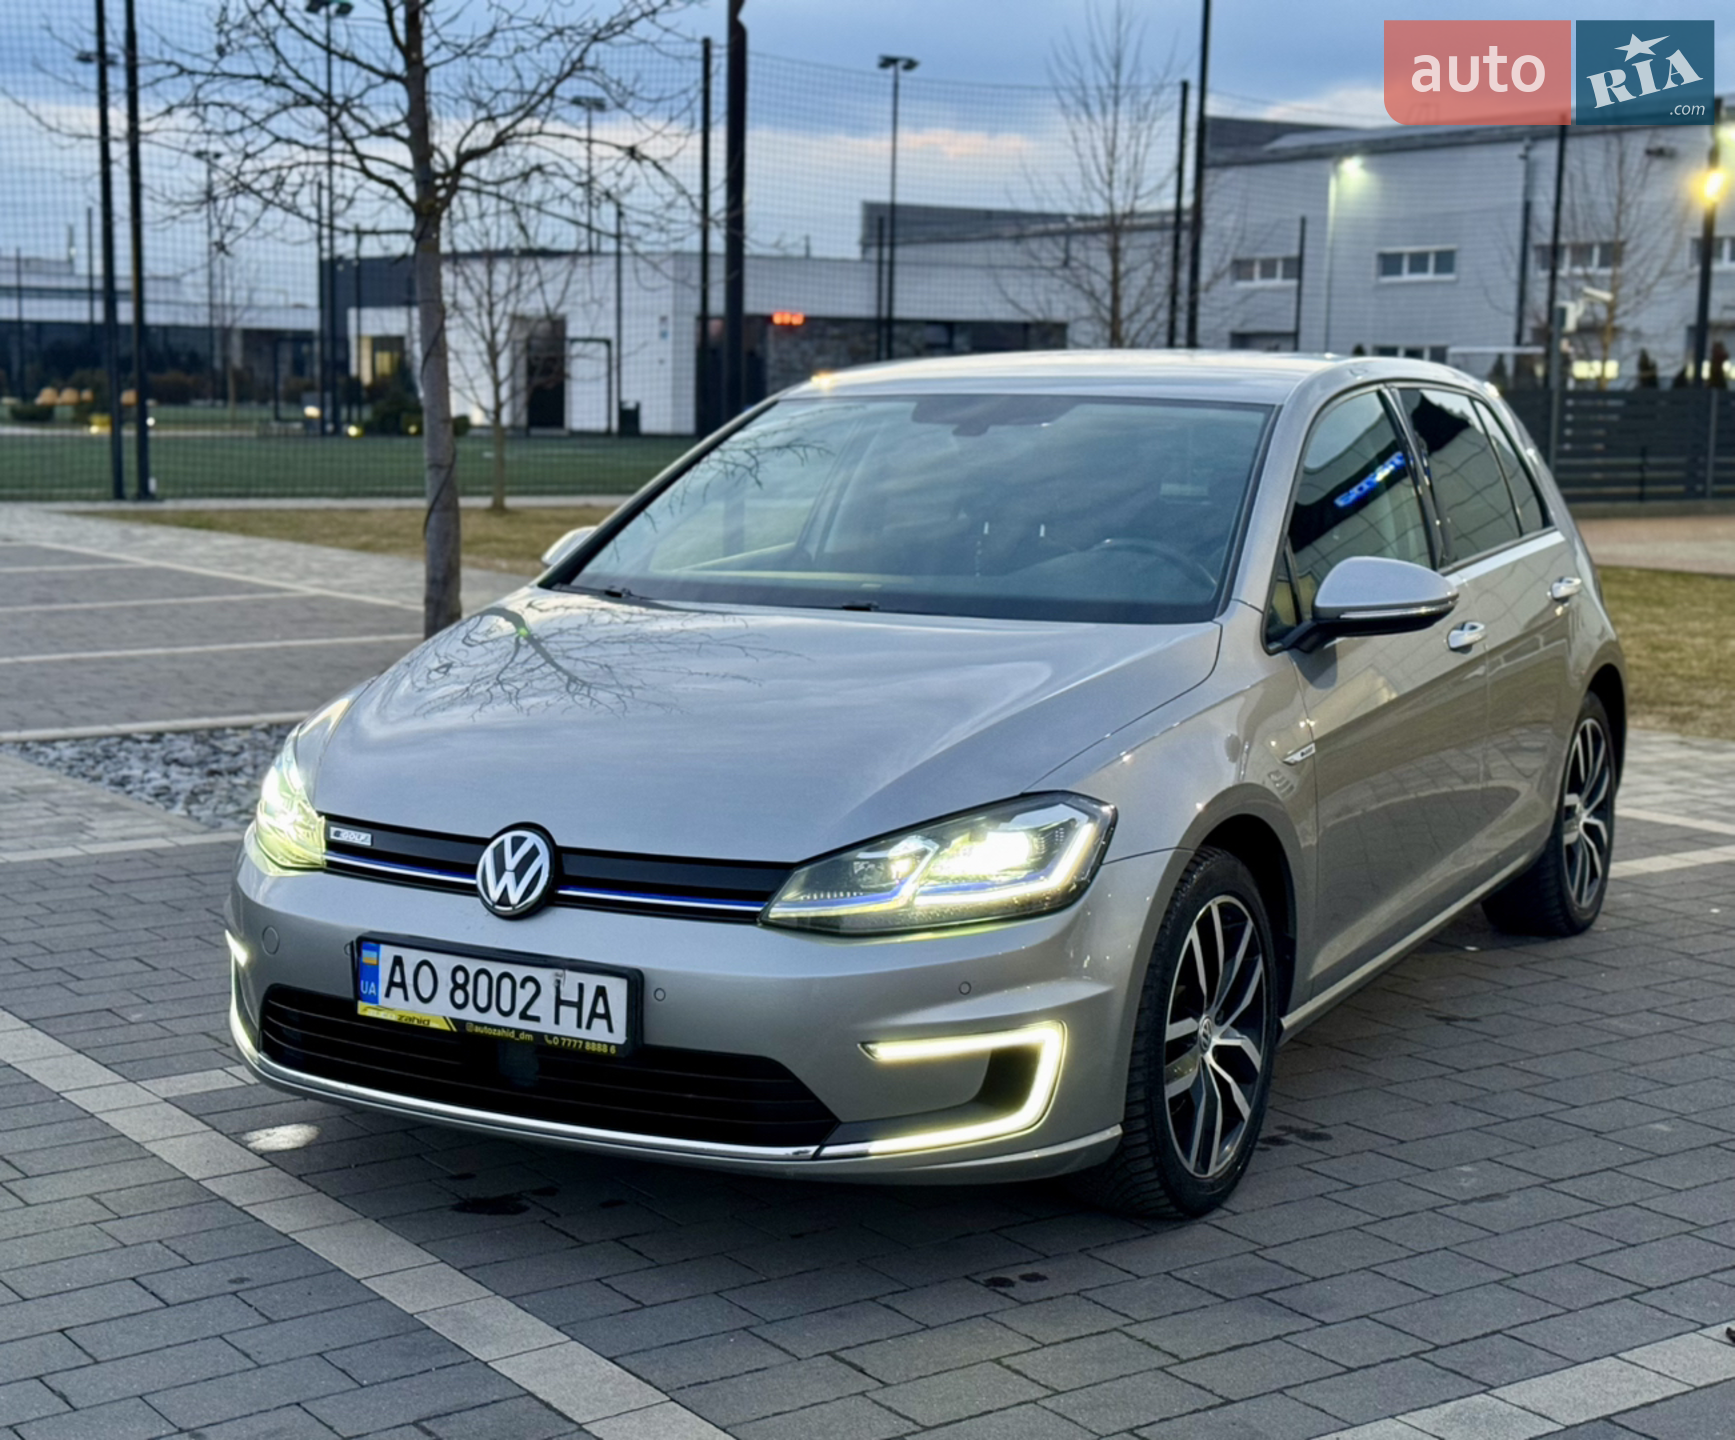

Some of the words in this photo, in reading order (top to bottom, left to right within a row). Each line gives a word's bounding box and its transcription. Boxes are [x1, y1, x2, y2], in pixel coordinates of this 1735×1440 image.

[360, 980, 377, 997] UA
[384, 955, 438, 1004] AO
[449, 964, 541, 1023] 8002
[554, 977, 614, 1034] HA
[560, 1037, 583, 1050] 7777
[585, 1041, 608, 1054] 8888
[609, 1044, 616, 1055] 6
